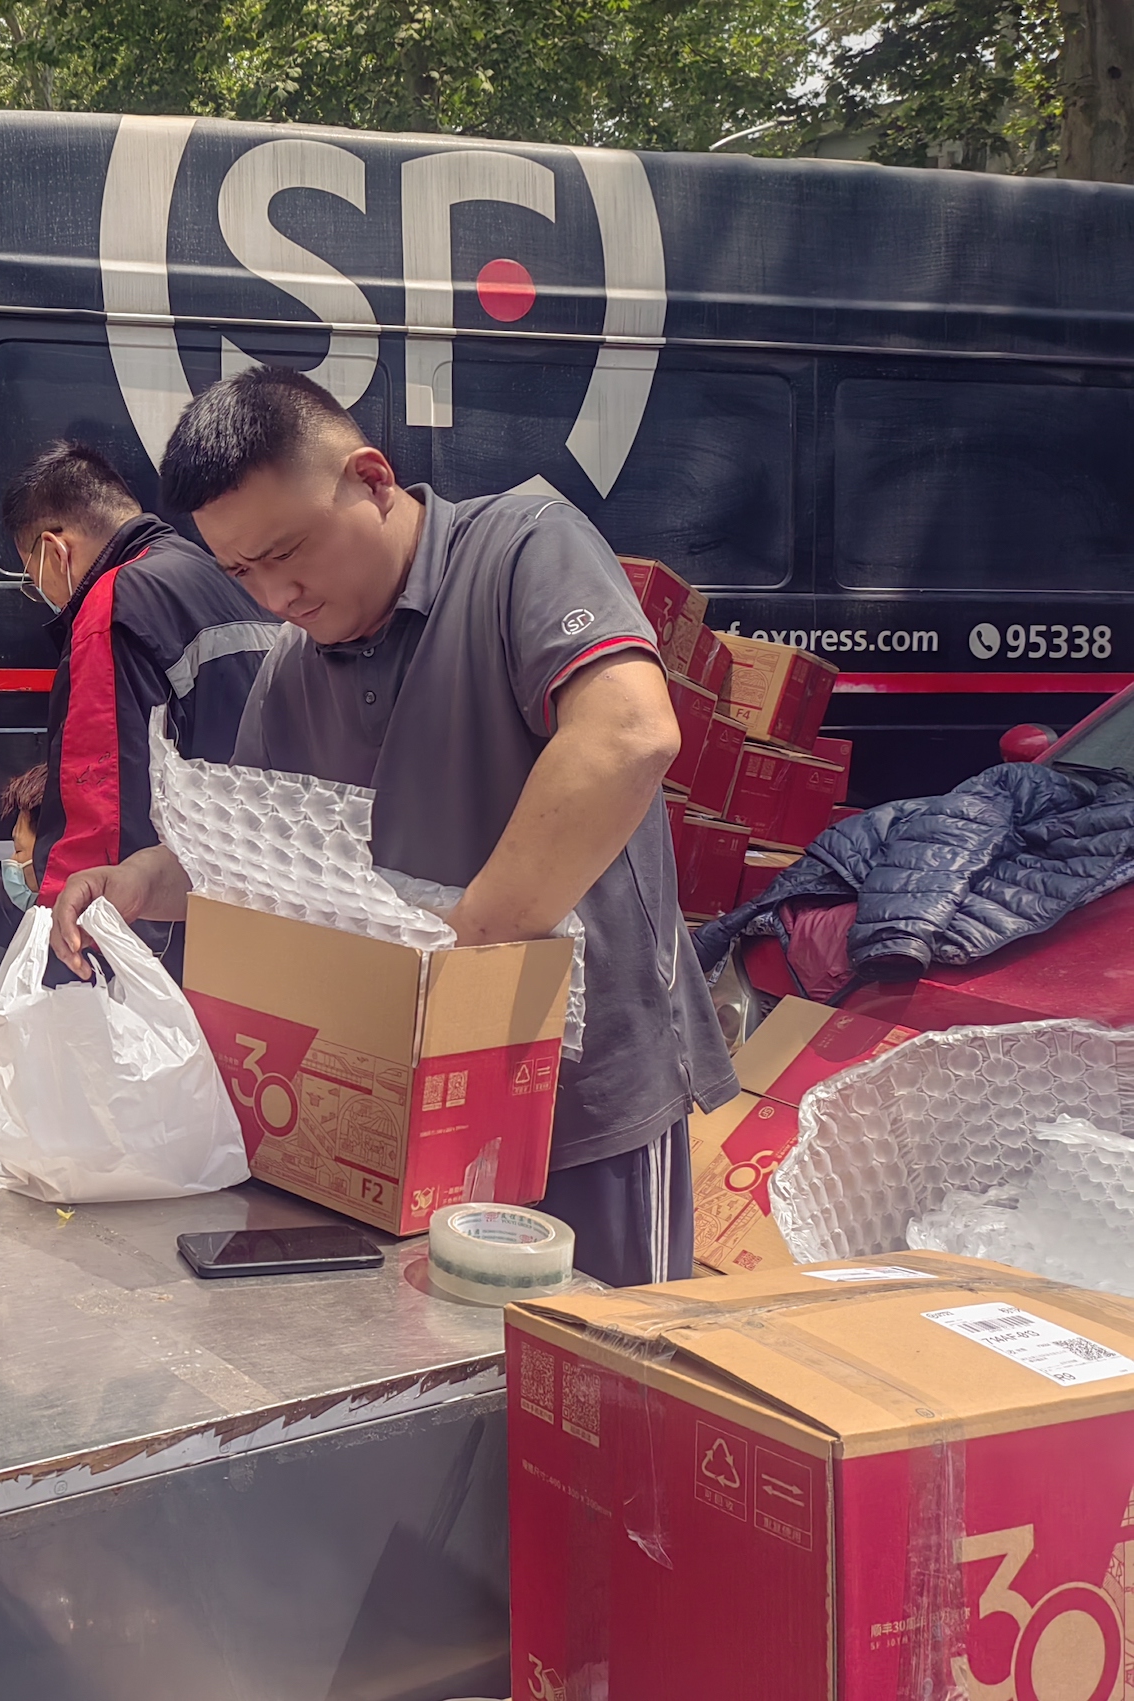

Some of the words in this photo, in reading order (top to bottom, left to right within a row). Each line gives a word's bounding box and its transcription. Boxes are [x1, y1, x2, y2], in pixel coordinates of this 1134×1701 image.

[1005, 624, 1112, 659] 95338
[735, 708, 751, 721] F4
[231, 1033, 299, 1139] 30
[361, 1176, 384, 1206] F2
[950, 1523, 1122, 1701] 30
